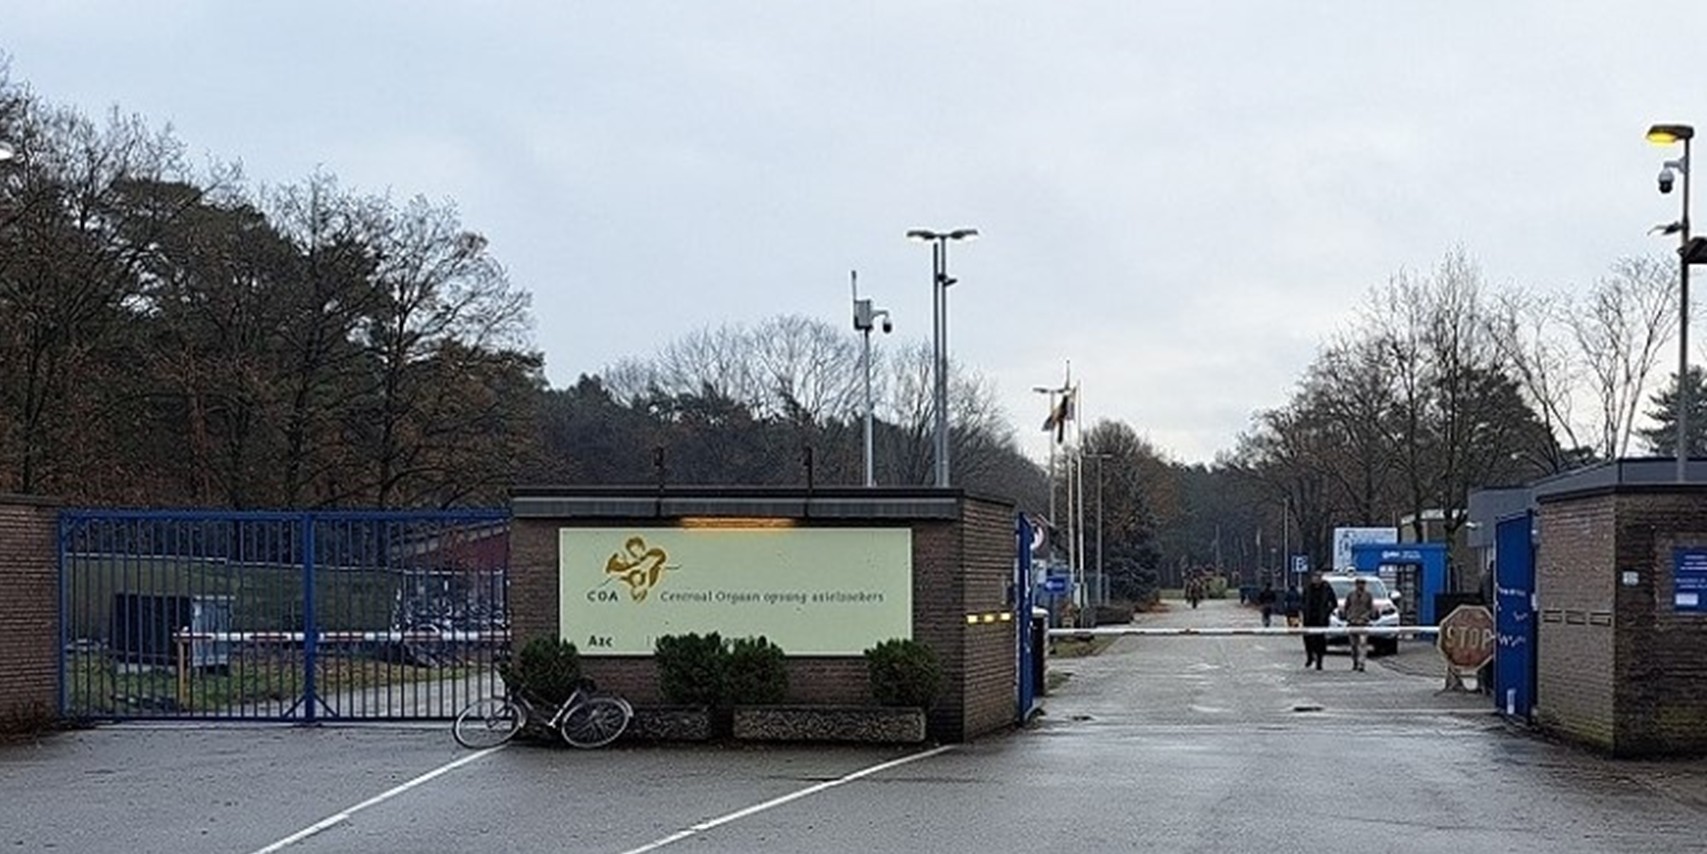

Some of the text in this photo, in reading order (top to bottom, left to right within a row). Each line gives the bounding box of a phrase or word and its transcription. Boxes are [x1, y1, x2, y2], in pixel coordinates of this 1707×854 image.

[586, 590, 619, 602] COA
[660, 590, 884, 605] Centraal Orgaan opvang asielzoekers
[1445, 625, 1492, 650] STOP
